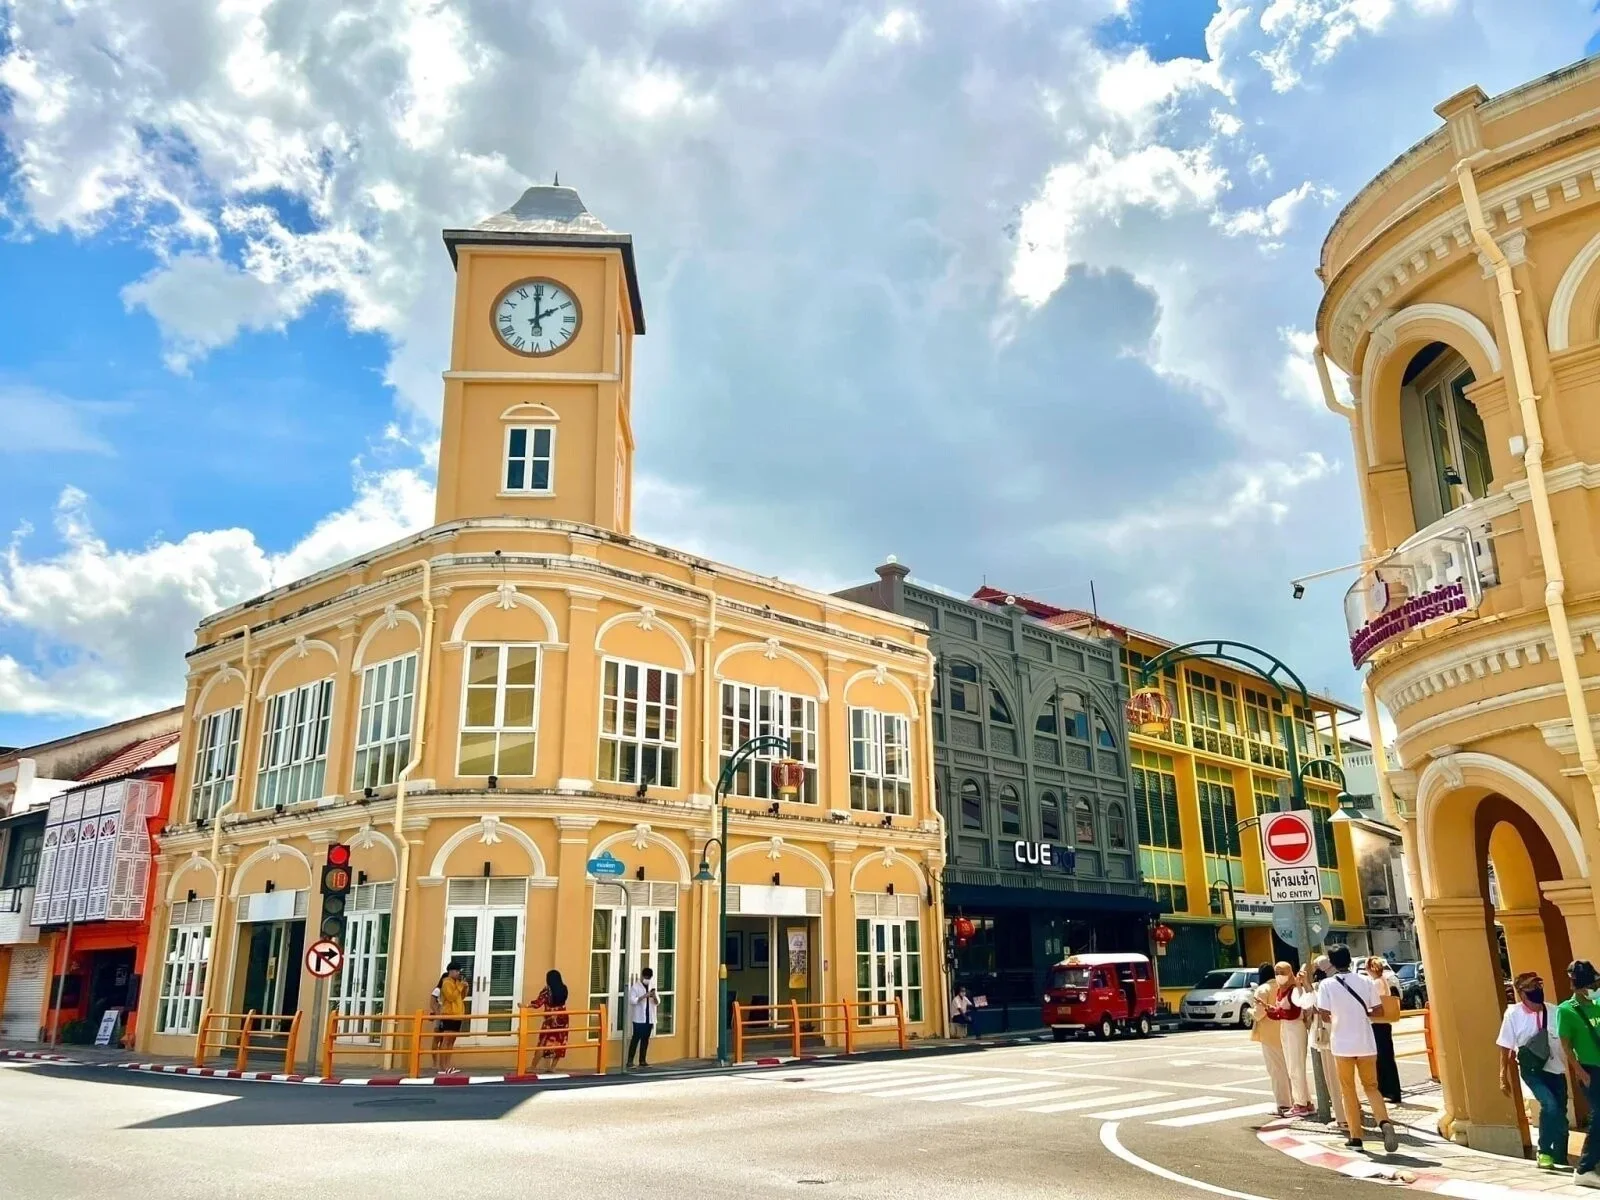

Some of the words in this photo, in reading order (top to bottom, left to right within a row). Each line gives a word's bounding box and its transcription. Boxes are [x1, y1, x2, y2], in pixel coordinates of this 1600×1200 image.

[517, 288, 529, 300] XI
[551, 290, 559, 300] I
[504, 299, 516, 309] X
[1407, 596, 1468, 628] MUSEUM
[1015, 840, 1052, 865] CUE
[332, 872, 346, 889] 10
[1271, 869, 1316, 888] ห้ามเข้า
[1276, 891, 1287, 899] NO
[1289, 890, 1313, 898] ENTRY
